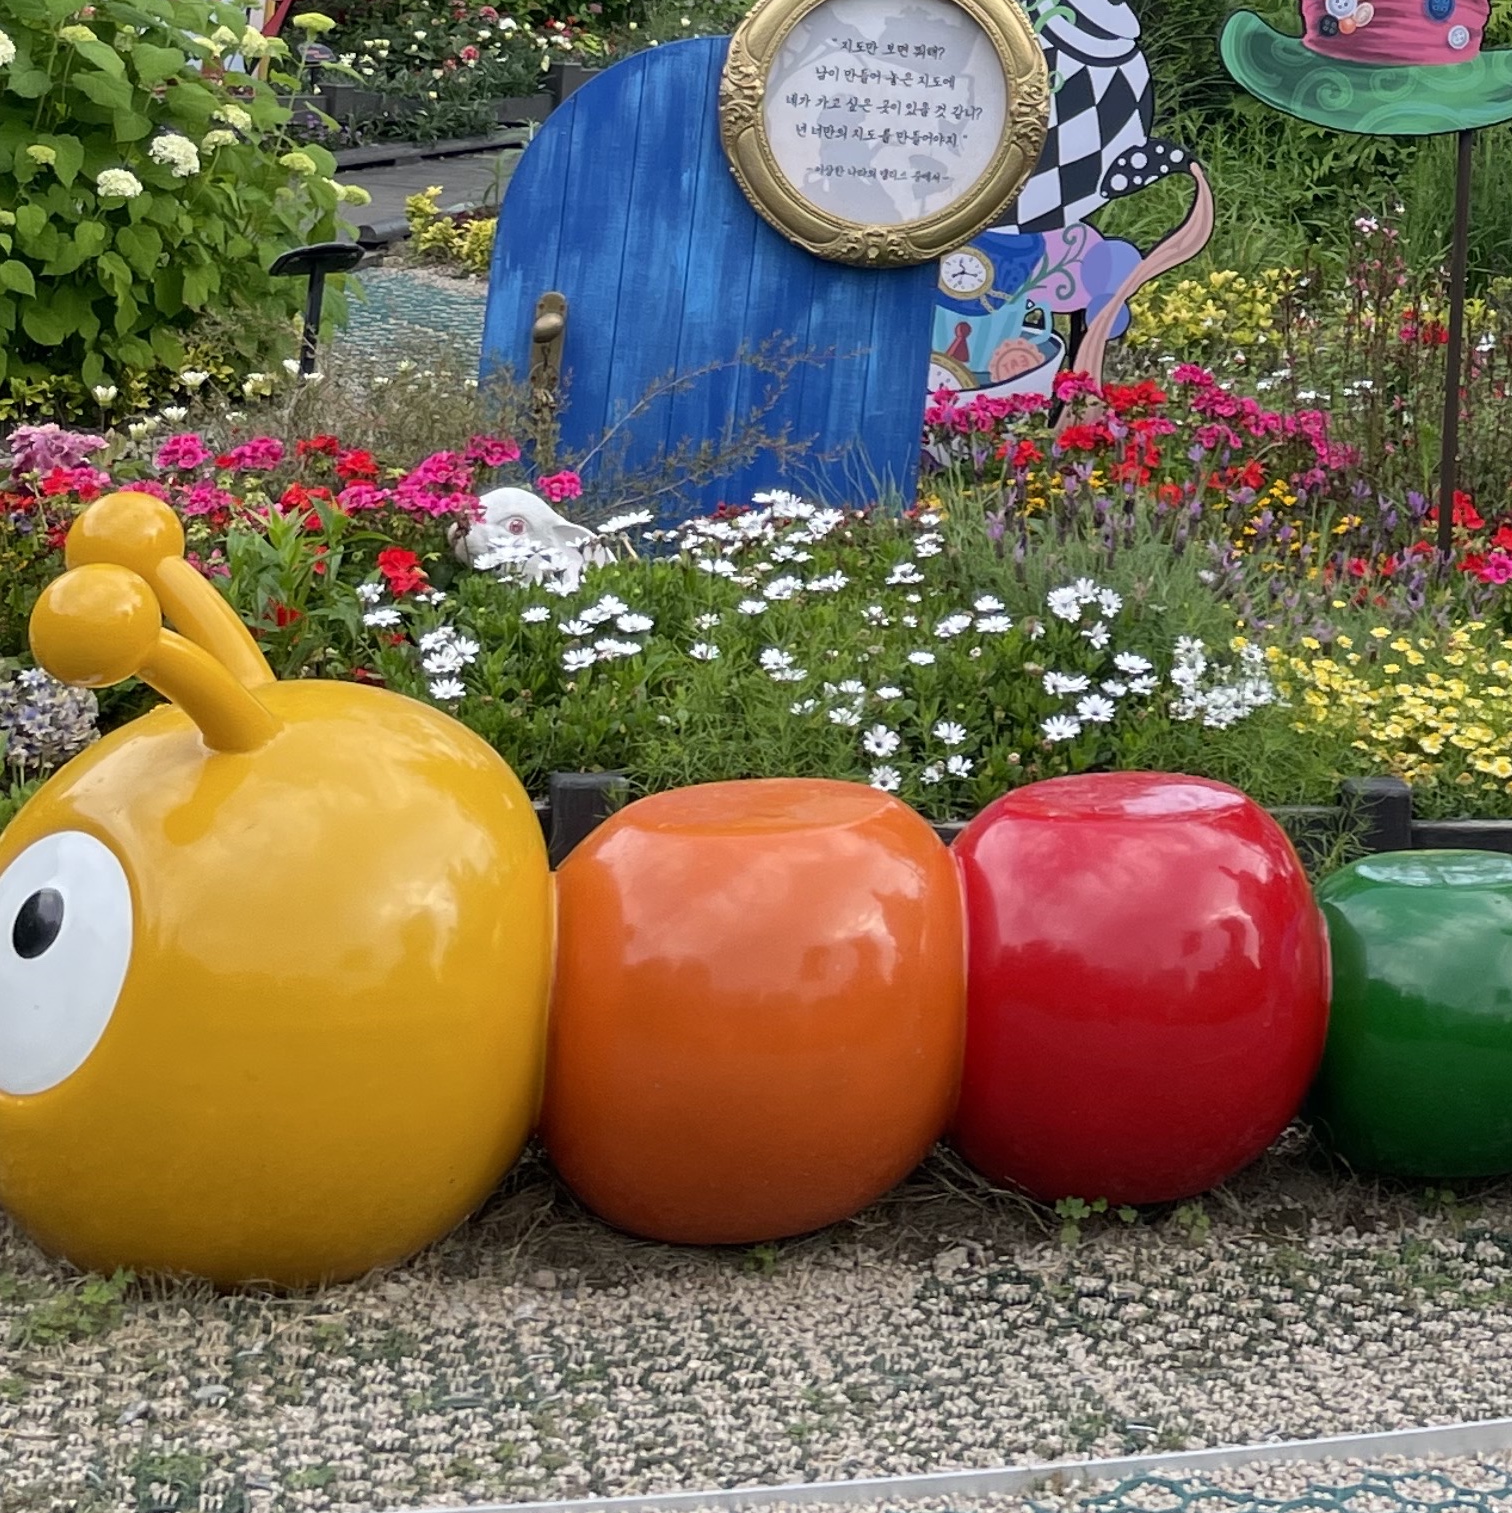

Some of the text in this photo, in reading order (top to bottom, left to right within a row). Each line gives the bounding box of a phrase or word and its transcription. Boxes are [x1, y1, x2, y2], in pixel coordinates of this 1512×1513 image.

[882, 43, 909, 57] 보면
[815, 65, 956, 90] 남이 만들어 놓은 지도에
[815, 93, 841, 110] 가고
[845, 97, 874, 114] 싶은
[876, 99, 902, 115] 곳이
[905, 102, 930, 118] 있을
[934, 104, 947, 119] 것
[795, 123, 808, 137] 넌
[811, 124, 848, 140] 너만의
[851, 127, 892, 144] 지도를
[847, 167, 877, 180] 나라의
